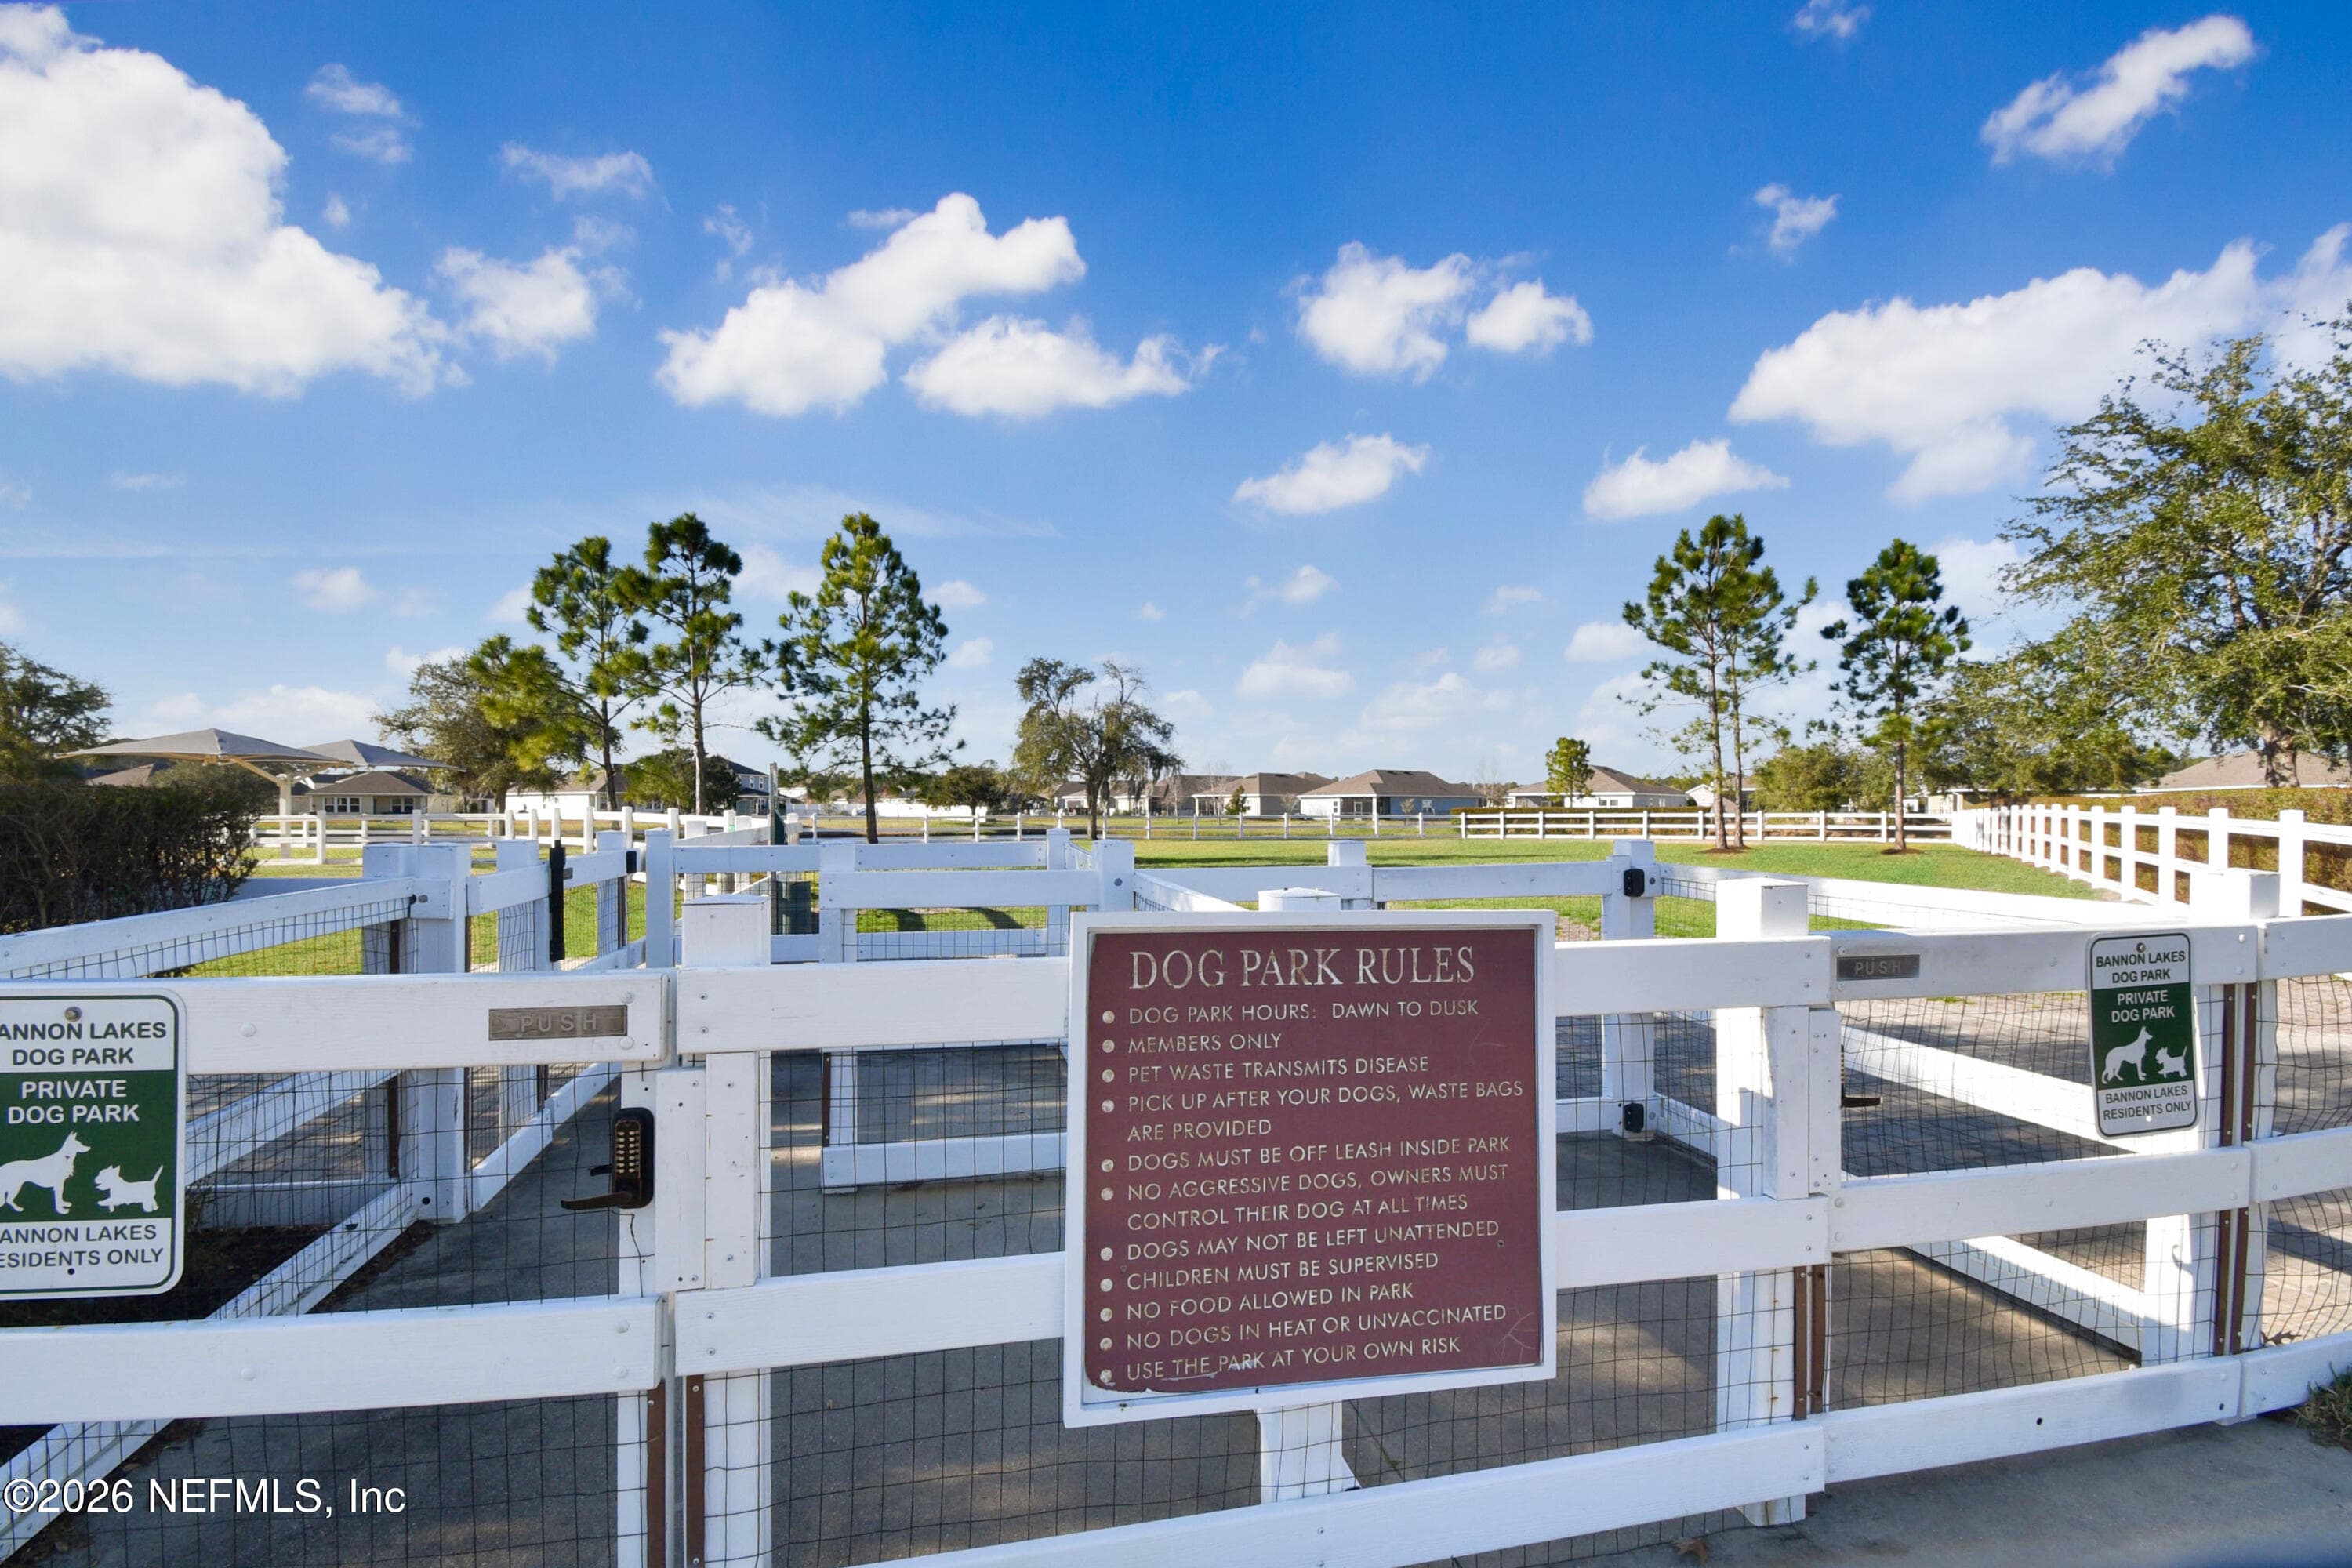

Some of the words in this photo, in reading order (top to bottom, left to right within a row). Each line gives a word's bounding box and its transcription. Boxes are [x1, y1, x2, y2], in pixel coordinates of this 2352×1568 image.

[1129, 949, 1228, 989] DOG
[1240, 948, 1344, 986] PARK
[1356, 946, 1475, 985] RULES
[1855, 961, 1900, 975] PUSH
[2096, 953, 2146, 967] BANNON
[2149, 950, 2185, 964] LAKES
[2112, 971, 2138, 983] DOG
[2140, 969, 2171, 981] PARK
[2117, 990, 2169, 1005] PRIVATE
[1129, 1007, 1178, 1025] DOG
[1188, 1005, 1234, 1022] PARK
[1242, 1004, 1317, 1021] HOURS:
[1333, 1002, 1389, 1018] DAWN
[1398, 1000, 1422, 1017] TO
[1430, 999, 1479, 1016] DUSK
[2111, 1009, 2140, 1022] DOG
[2143, 1006, 2176, 1020] PARK
[0, 1023, 82, 1040] ANNON
[89, 1022, 167, 1039] LAKES
[520, 1014, 597, 1033] PUSH
[1128, 1035, 1221, 1054] MEMBERS
[1229, 1033, 1283, 1050] ONLY
[12, 1048, 65, 1066] DOG
[72, 1047, 135, 1064] PARK
[1129, 1065, 1162, 1083] PET
[1170, 1063, 1234, 1080] WASTE
[1242, 1058, 1348, 1078] TRANSMITS
[1355, 1057, 1428, 1074] DISEASE
[21, 1080, 127, 1098] PRIVATE
[1129, 1094, 1173, 1112] PICK
[1182, 1093, 1206, 1110] UP
[1212, 1091, 1269, 1109] AFTER
[1278, 1088, 1331, 1105] YOUR
[1338, 1086, 1400, 1104] DOGS,
[1409, 1083, 1468, 1100] WASTE
[1475, 1080, 1523, 1098] BAGS
[2106, 1089, 2151, 1104] BANNON
[2154, 1085, 2187, 1098] LAKES
[8, 1105, 65, 1124] DOG
[72, 1104, 140, 1122] PARK
[2103, 1103, 2163, 1120] RESIDENTS
[2166, 1100, 2192, 1113] ONLY
[1127, 1124, 1163, 1142] ARE
[1173, 1120, 1272, 1139] PROVIDED
[1128, 1152, 1190, 1171] DOGS
[1198, 1149, 1251, 1167] MUST
[1261, 1146, 1281, 1163] BE
[1289, 1145, 1328, 1162] OFF
[1335, 1142, 1392, 1160] LEASH
[1400, 1138, 1461, 1156] INSIDE
[1469, 1137, 1510, 1152] PARK
[1128, 1184, 1162, 1201] NO
[1169, 1176, 1290, 1198] AGGRESSIVE
[1299, 1173, 1362, 1191] DOGS,
[1370, 1167, 1452, 1186] OWNERS
[1459, 1163, 1508, 1182] MUST
[1127, 1210, 1229, 1231] CONTROL
[1235, 1205, 1289, 1225] THEIR
[1297, 1201, 1344, 1220] DOG
[1352, 1200, 1372, 1217] AT
[1378, 1197, 1410, 1215] ALL
[1415, 1195, 1468, 1212] TIMES
[0, 1228, 78, 1243] ANNON
[86, 1225, 157, 1242] LAKES
[1127, 1240, 1189, 1261] DOGS
[1197, 1237, 1239, 1256] MAY
[1247, 1234, 1289, 1253] NOT
[1297, 1232, 1318, 1248] BE
[1327, 1229, 1366, 1247] LEFT
[1375, 1220, 1499, 1243] UNATTENDED
[0, 1251, 100, 1268] ESIDENTS
[107, 1248, 163, 1264] ONLY
[1127, 1268, 1229, 1290] CHILDREN
[1237, 1262, 1290, 1281] MUST
[1300, 1261, 1320, 1277] BE
[1328, 1253, 1438, 1276] SUPERVISED
[1127, 1301, 1161, 1320] NO
[1170, 1297, 1231, 1316] FOOD
[1239, 1289, 1333, 1311] ALLOWED
[1342, 1286, 1360, 1302] IN
[1370, 1283, 1414, 1300] PARK
[1127, 1333, 1160, 1350] NO
[1170, 1327, 1231, 1345] DOGS
[1240, 1323, 1260, 1340] IN
[1269, 1319, 1316, 1338] HEAT
[1323, 1317, 1350, 1334] OR
[1359, 1305, 1505, 1330] UNVACCINATED
[1127, 1362, 1163, 1381] USE
[1173, 1358, 1210, 1377] THE
[1218, 1353, 1265, 1372] PARK
[1272, 1350, 1294, 1367] AT
[1301, 1345, 1356, 1365] YOUR
[1364, 1341, 1413, 1361] OWN
[1422, 1338, 1460, 1356] RISK
